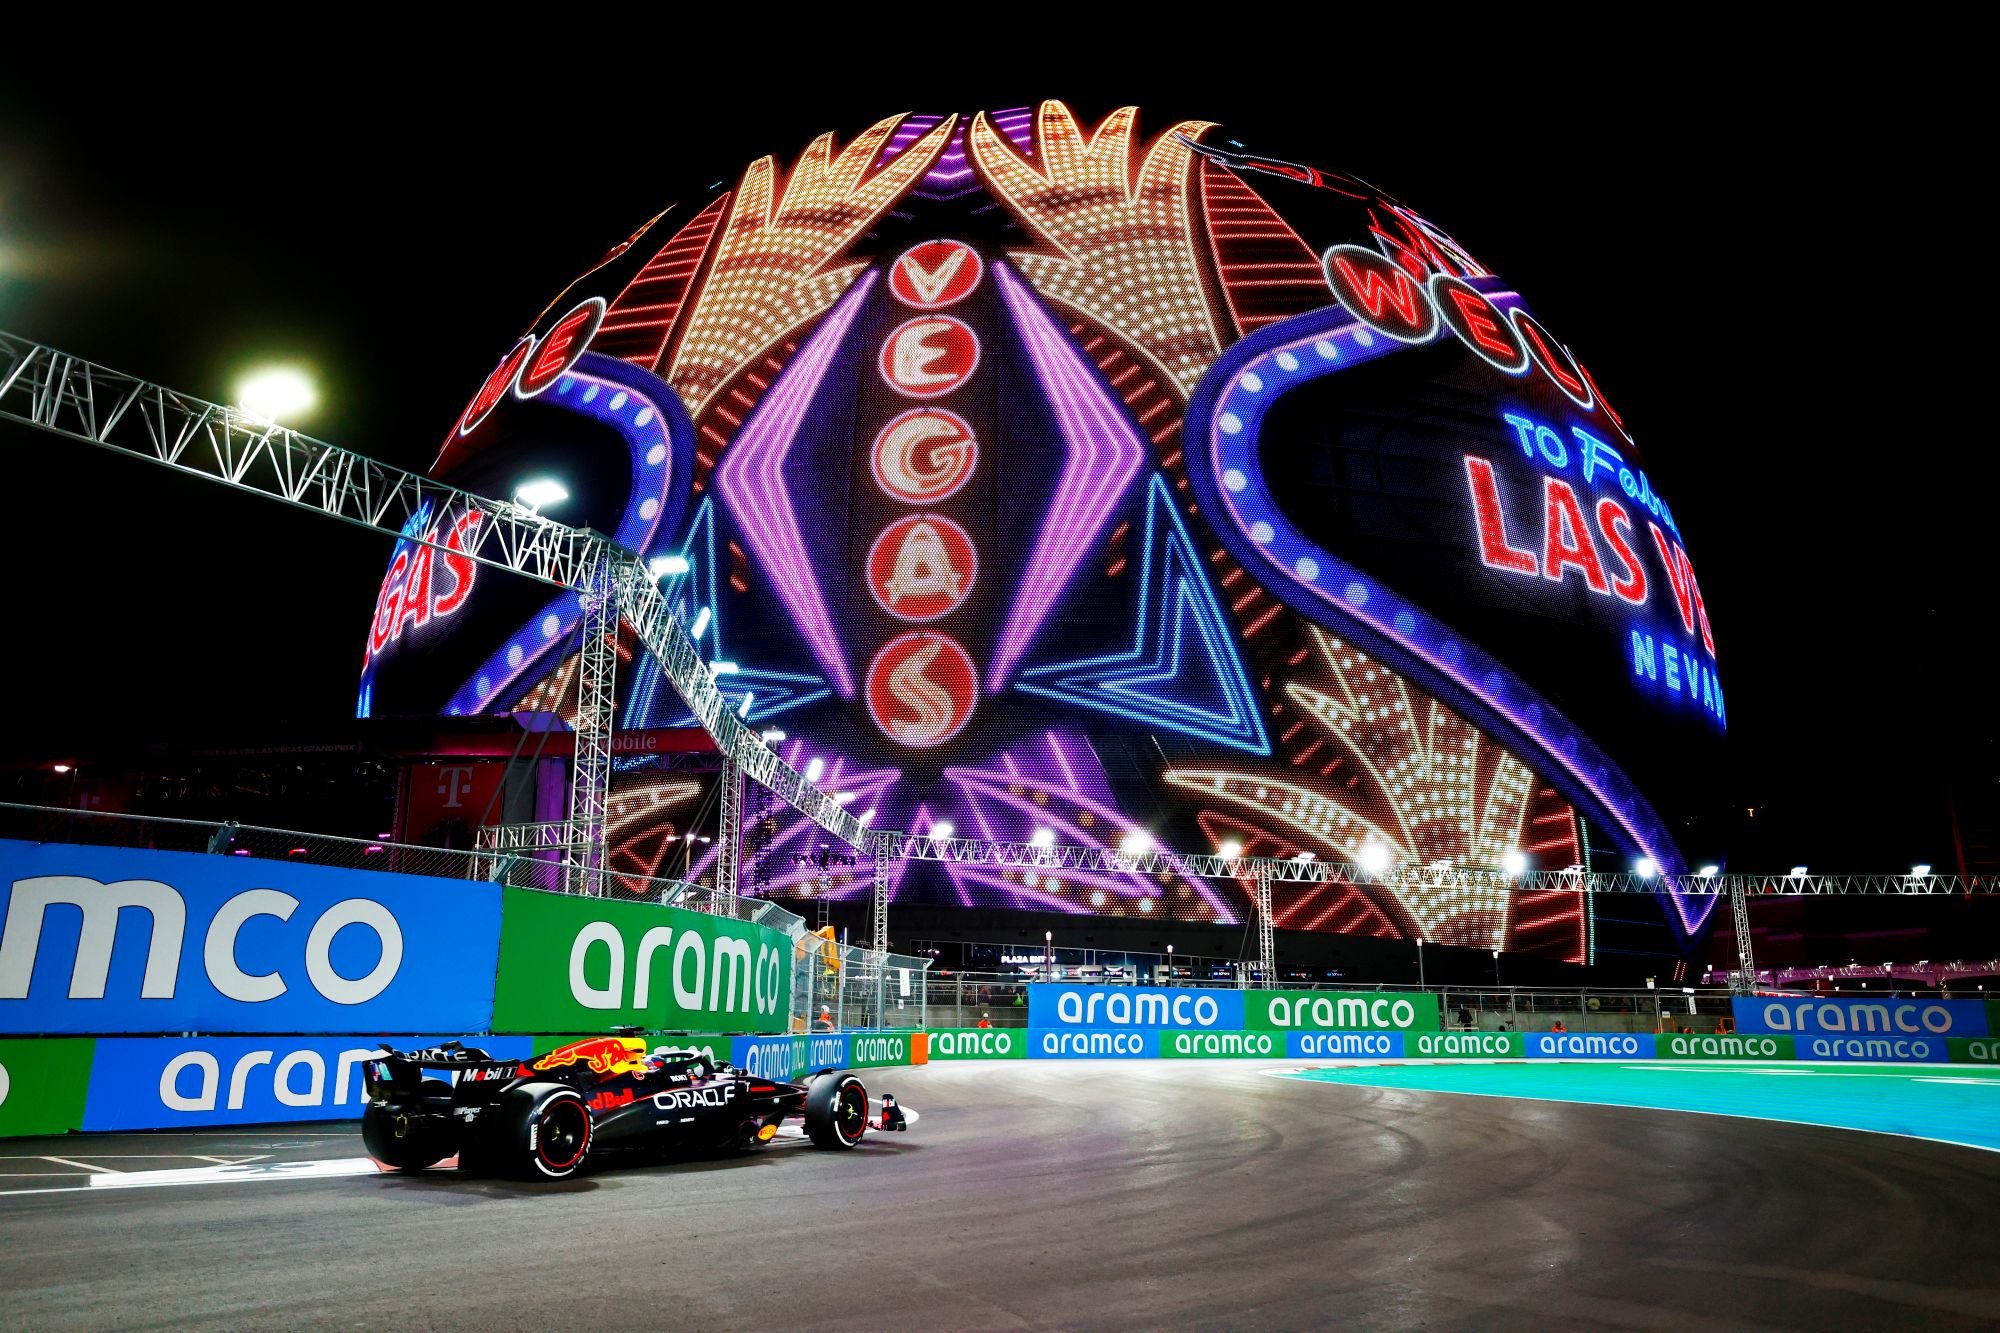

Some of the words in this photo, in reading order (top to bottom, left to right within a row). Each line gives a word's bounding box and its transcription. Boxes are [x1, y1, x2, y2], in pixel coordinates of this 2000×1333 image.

[1504, 413, 1567, 468] TO
[880, 248, 976, 748] VEGAS
[1464, 454, 1649, 605] LAS
[361, 508, 484, 678] GAS
[569, 921, 780, 1016] aramco
[1001, 955, 1028, 964] PLAZA
[1029, 955, 1057, 964] ENTY
[1058, 991, 1219, 1026] aramco
[1269, 998, 1415, 1028] aramco
[1763, 1003, 1952, 1033] aramco
[810, 1039, 843, 1067] aramco
[856, 1038, 903, 1062] aramco
[928, 1033, 1012, 1055] ramco
[1043, 1033, 1144, 1054] aramco
[1175, 1034, 1272, 1054] aramco
[1300, 1034, 1391, 1054] aramco
[1419, 1035, 1510, 1054] aramco
[1540, 1036, 1638, 1055] aramco
[1671, 1037, 1777, 1056] aramco
[1812, 1039, 1930, 1058] aramco
[745, 1043, 790, 1080] aramco
[463, 1067, 504, 1082] Mobil
[604, 1087, 634, 1109] Bull
